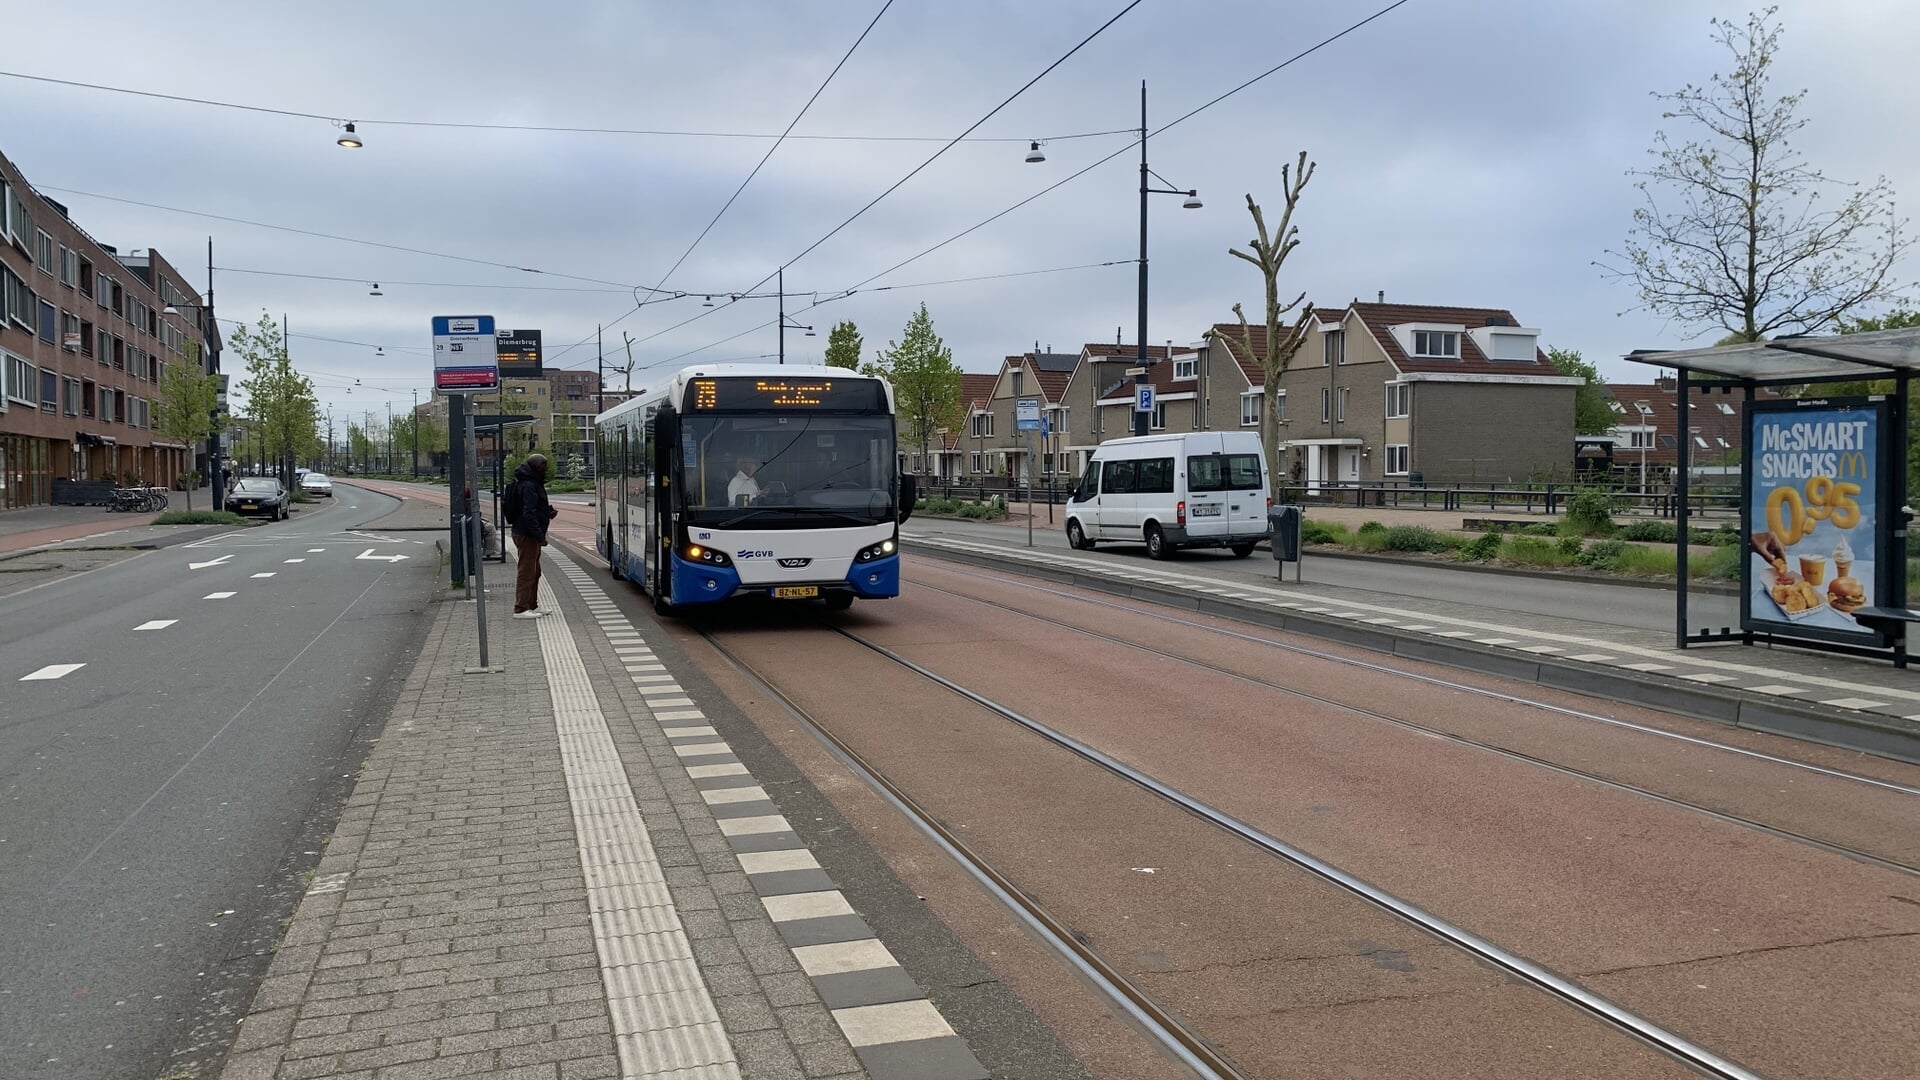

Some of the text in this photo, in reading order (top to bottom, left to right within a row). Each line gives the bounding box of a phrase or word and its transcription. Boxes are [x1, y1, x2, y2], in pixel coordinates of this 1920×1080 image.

[1762, 421, 1868, 451] McSMART
[1762, 452, 1837, 479] SNACKS
[755, 550, 774, 558] GVB
[782, 559, 807, 567] VDL
[778, 587, 815, 597] BZ-NL-57
